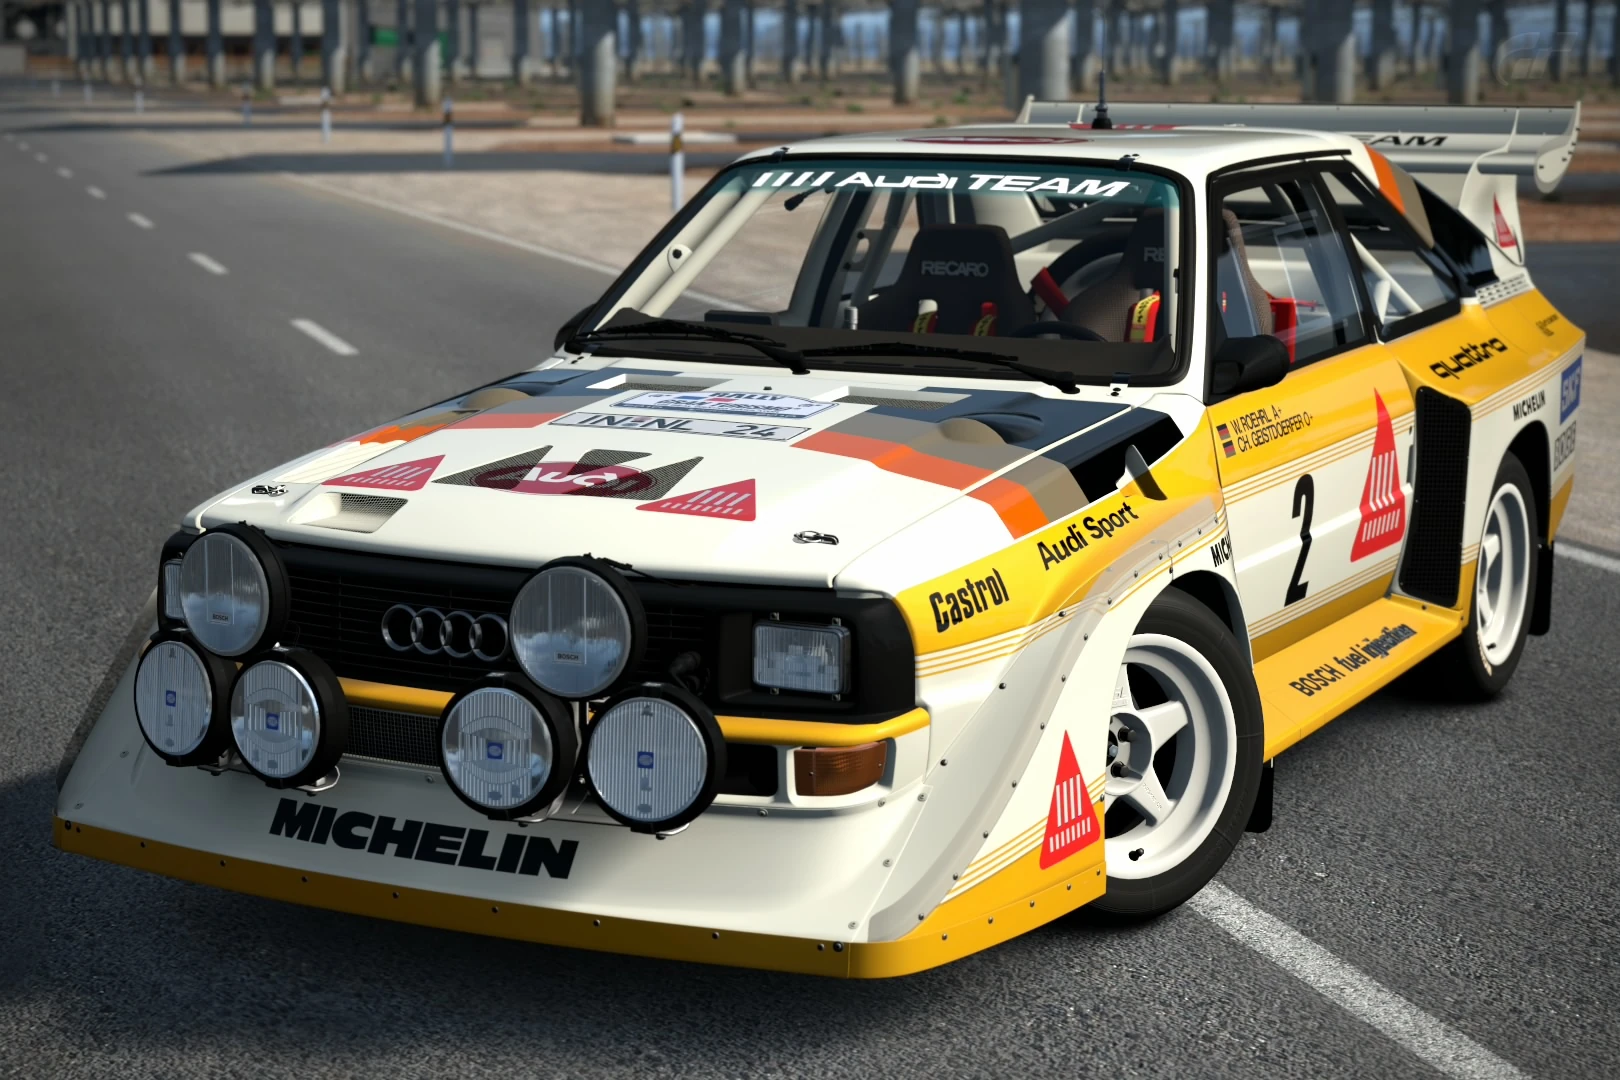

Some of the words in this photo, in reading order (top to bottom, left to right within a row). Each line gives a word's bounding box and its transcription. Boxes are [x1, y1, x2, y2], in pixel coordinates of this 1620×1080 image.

[835, 171, 958, 190] Audi
[967, 173, 1131, 198] TEAM
[921, 260, 989, 278] RECARO
[1429, 337, 1508, 380] quattro
[709, 392, 784, 401] RALLY
[1512, 389, 1546, 421] MICHELIN
[578, 415, 633, 427] IN
[640, 418, 693, 431] NL
[722, 424, 781, 437] 24
[1240, 407, 1273, 431] ROEHRL
[1250, 413, 1305, 448] GEISTDOERFER
[1037, 523, 1089, 571] Audi
[1083, 501, 1139, 540] Sport
[1284, 473, 1315, 608] 2
[929, 567, 1010, 633] Castrol
[212, 613, 229, 622] BOSCH
[557, 653, 579, 661] BOSCH
[1288, 663, 1346, 697] BOSCH
[1332, 646, 1371, 672] fuel
[269, 797, 580, 880] MICHELIN
